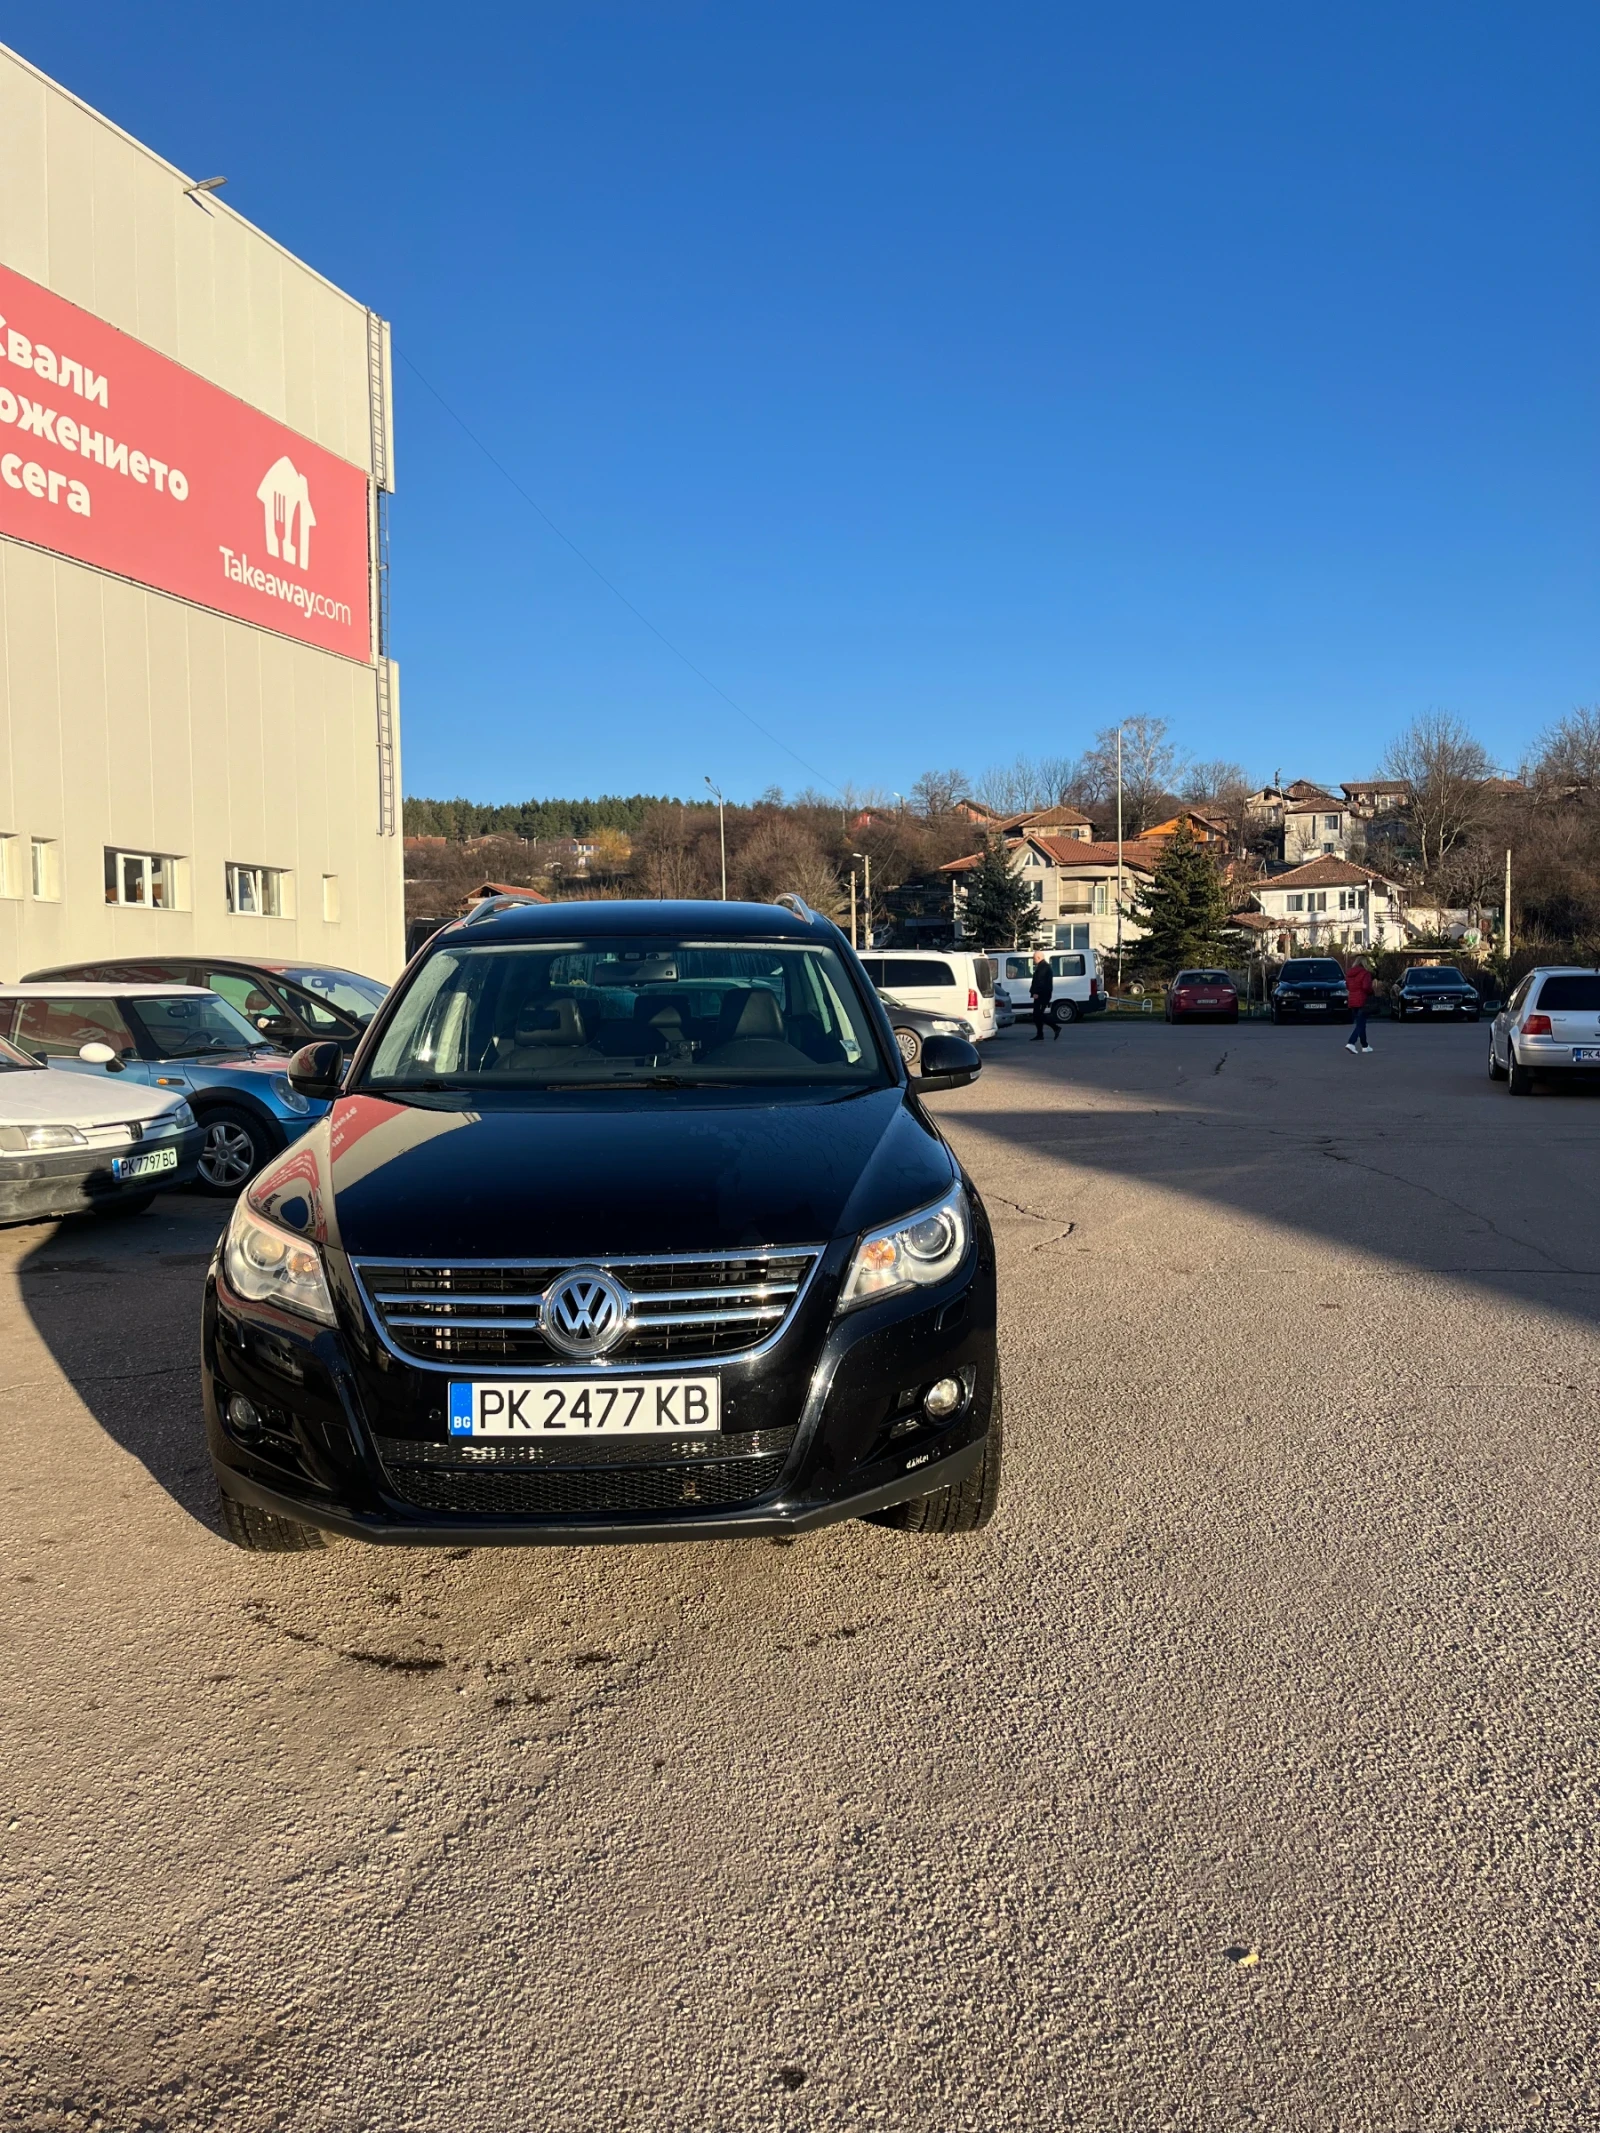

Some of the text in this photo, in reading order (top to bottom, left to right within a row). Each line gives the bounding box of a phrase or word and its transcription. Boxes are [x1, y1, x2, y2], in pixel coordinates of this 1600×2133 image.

[0, 314, 109, 409] вали
[1, 453, 91, 517] сега
[219, 545, 351, 626] Takeaway.com
[121, 1151, 175, 1176] PK 7797 BC
[548, 1276, 619, 1346] VW
[453, 1416, 471, 1429] BG
[480, 1385, 709, 1429] PK 2477 KB
